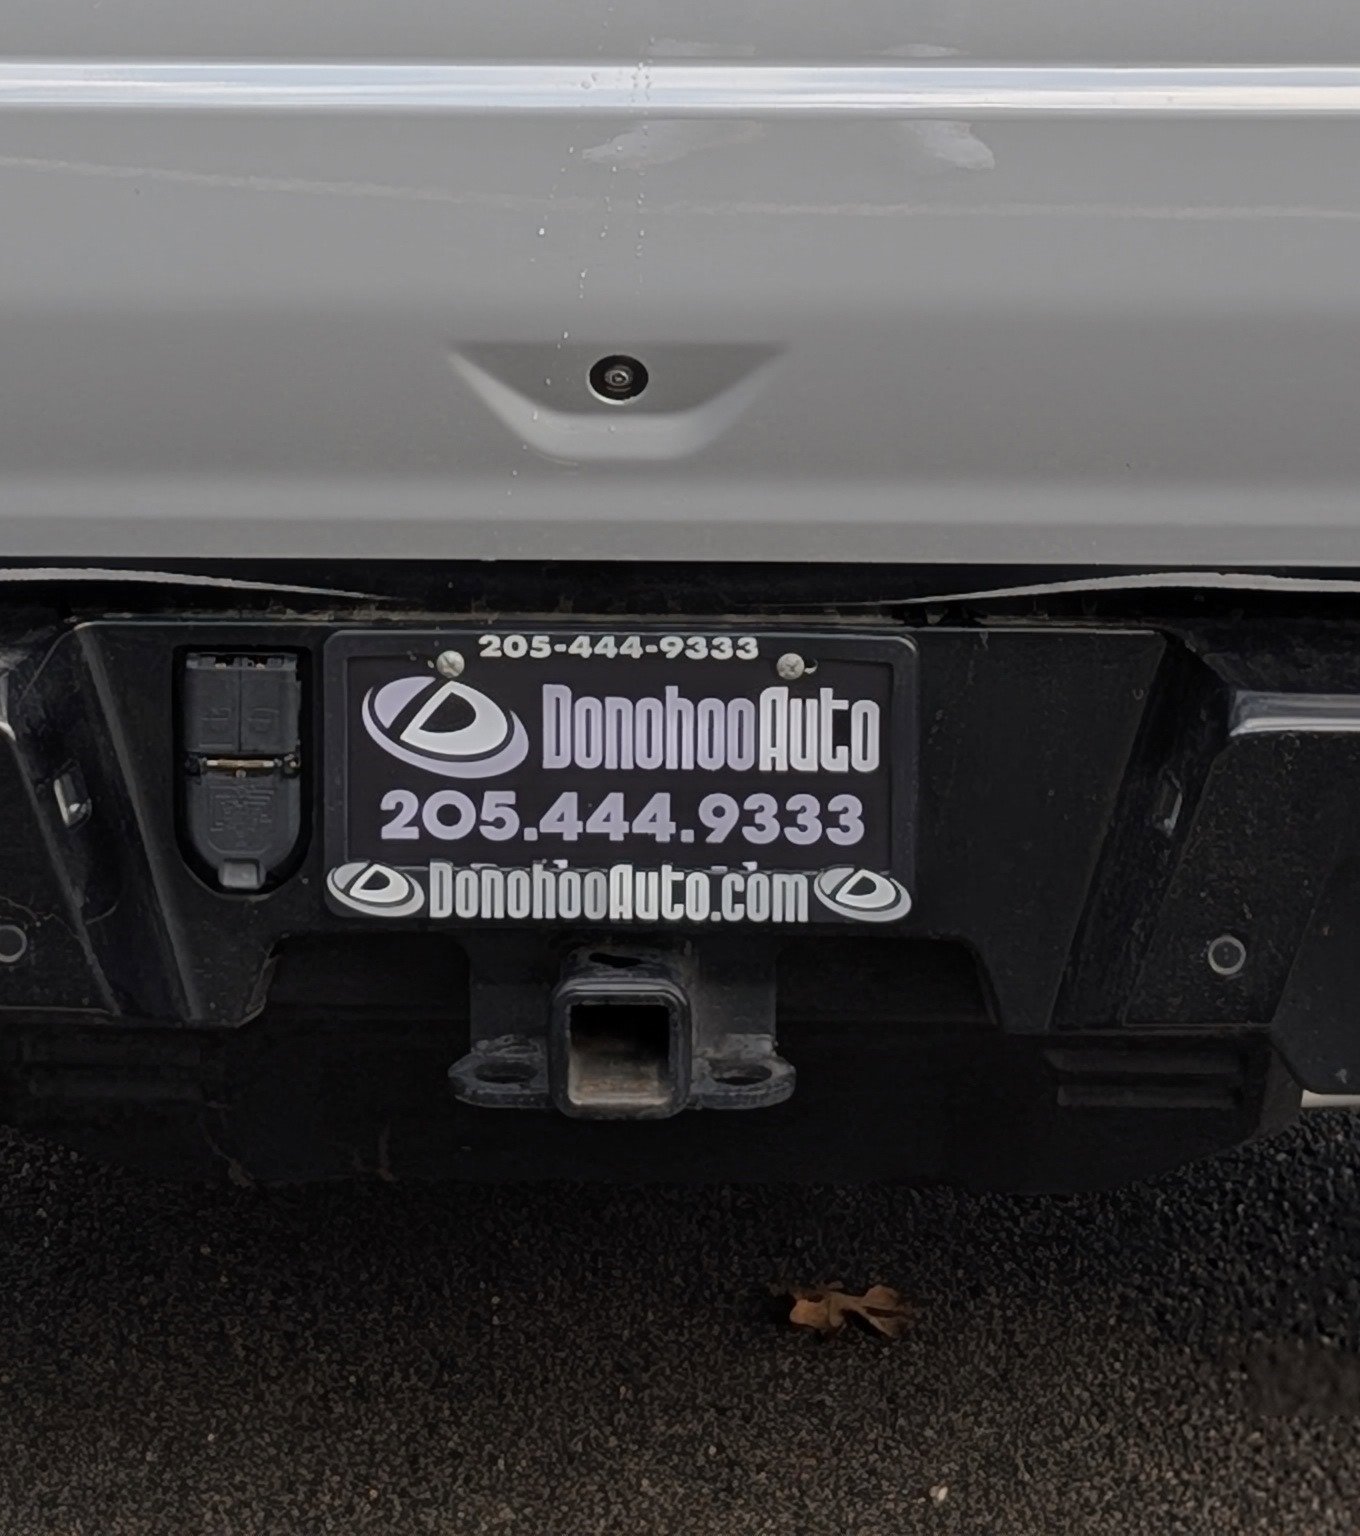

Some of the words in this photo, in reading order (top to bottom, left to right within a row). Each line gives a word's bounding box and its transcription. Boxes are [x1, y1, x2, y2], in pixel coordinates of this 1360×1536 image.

[477, 635, 759, 660] 205-444-9333
[380, 790, 866, 846] 205.444.9333
[428, 861, 809, 924] DonohooAuto.com
